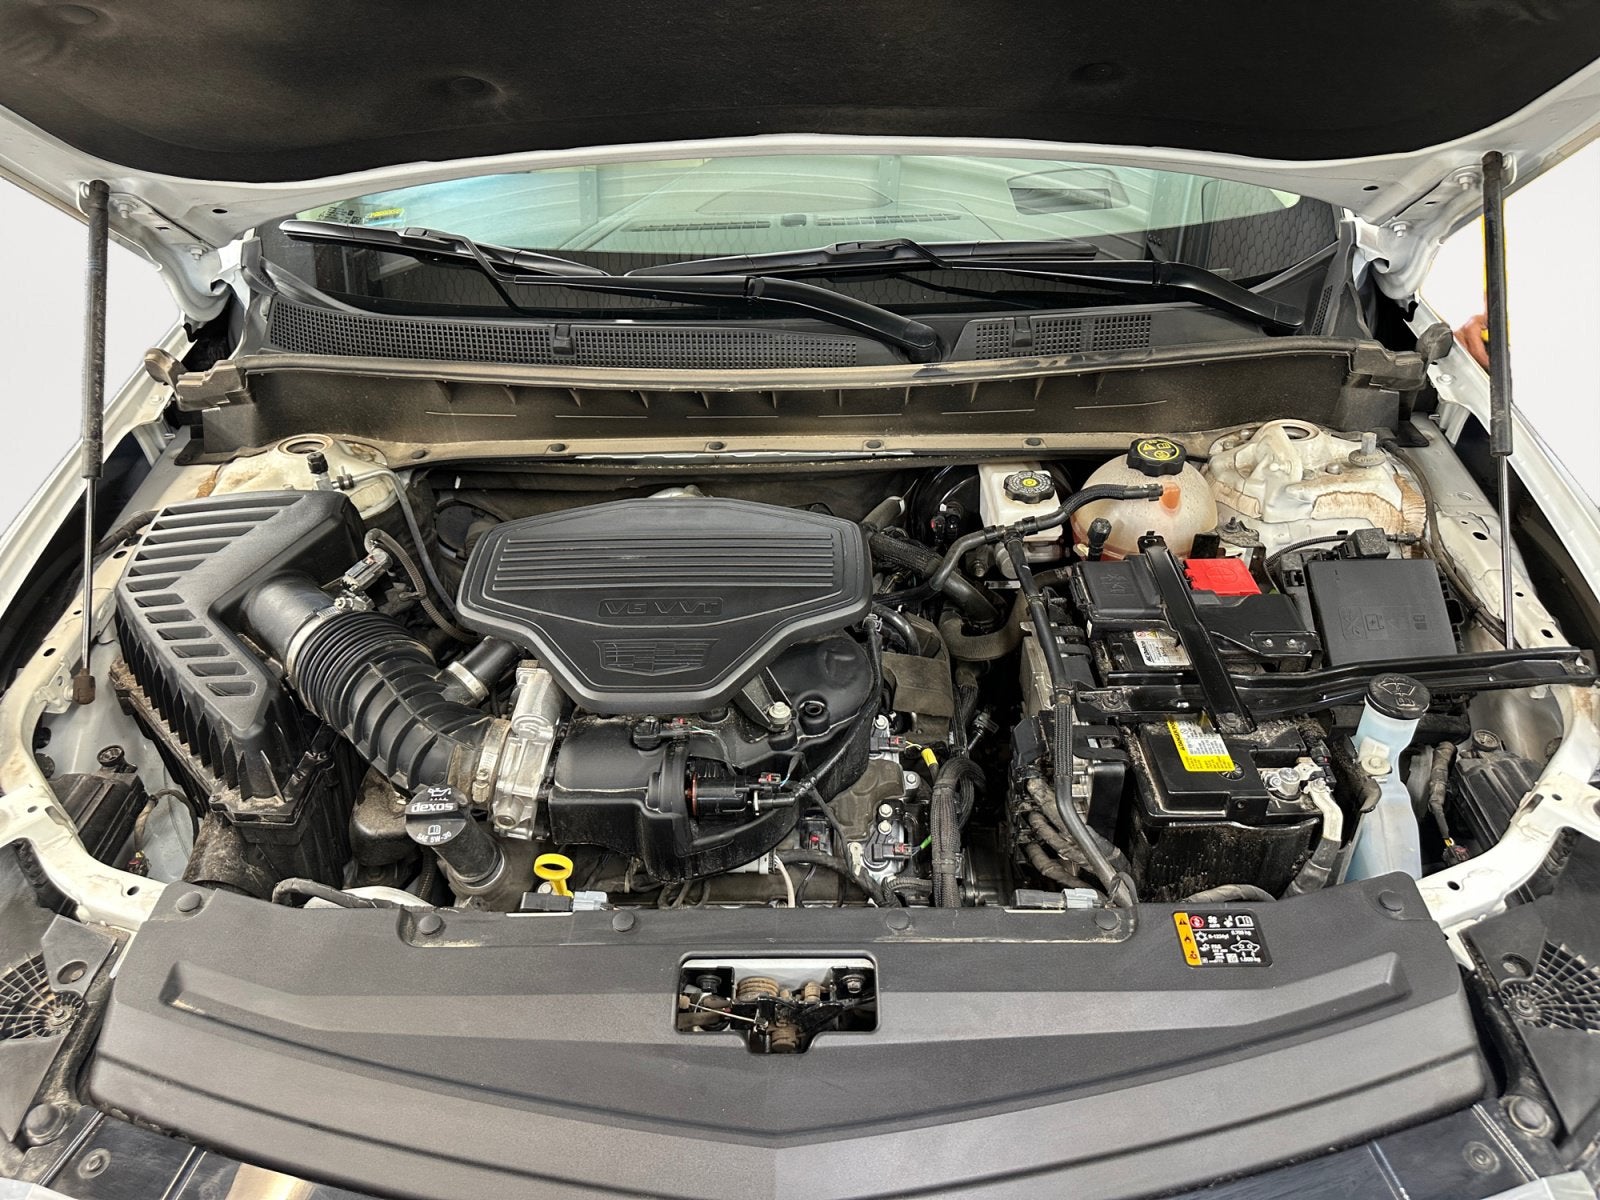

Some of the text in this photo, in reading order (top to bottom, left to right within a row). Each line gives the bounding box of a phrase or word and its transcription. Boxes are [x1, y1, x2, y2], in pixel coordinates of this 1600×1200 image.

[604, 600, 719, 615] V6 VVT
[411, 802, 454, 812] dexos
[416, 831, 452, 843] SAE 5W-30
